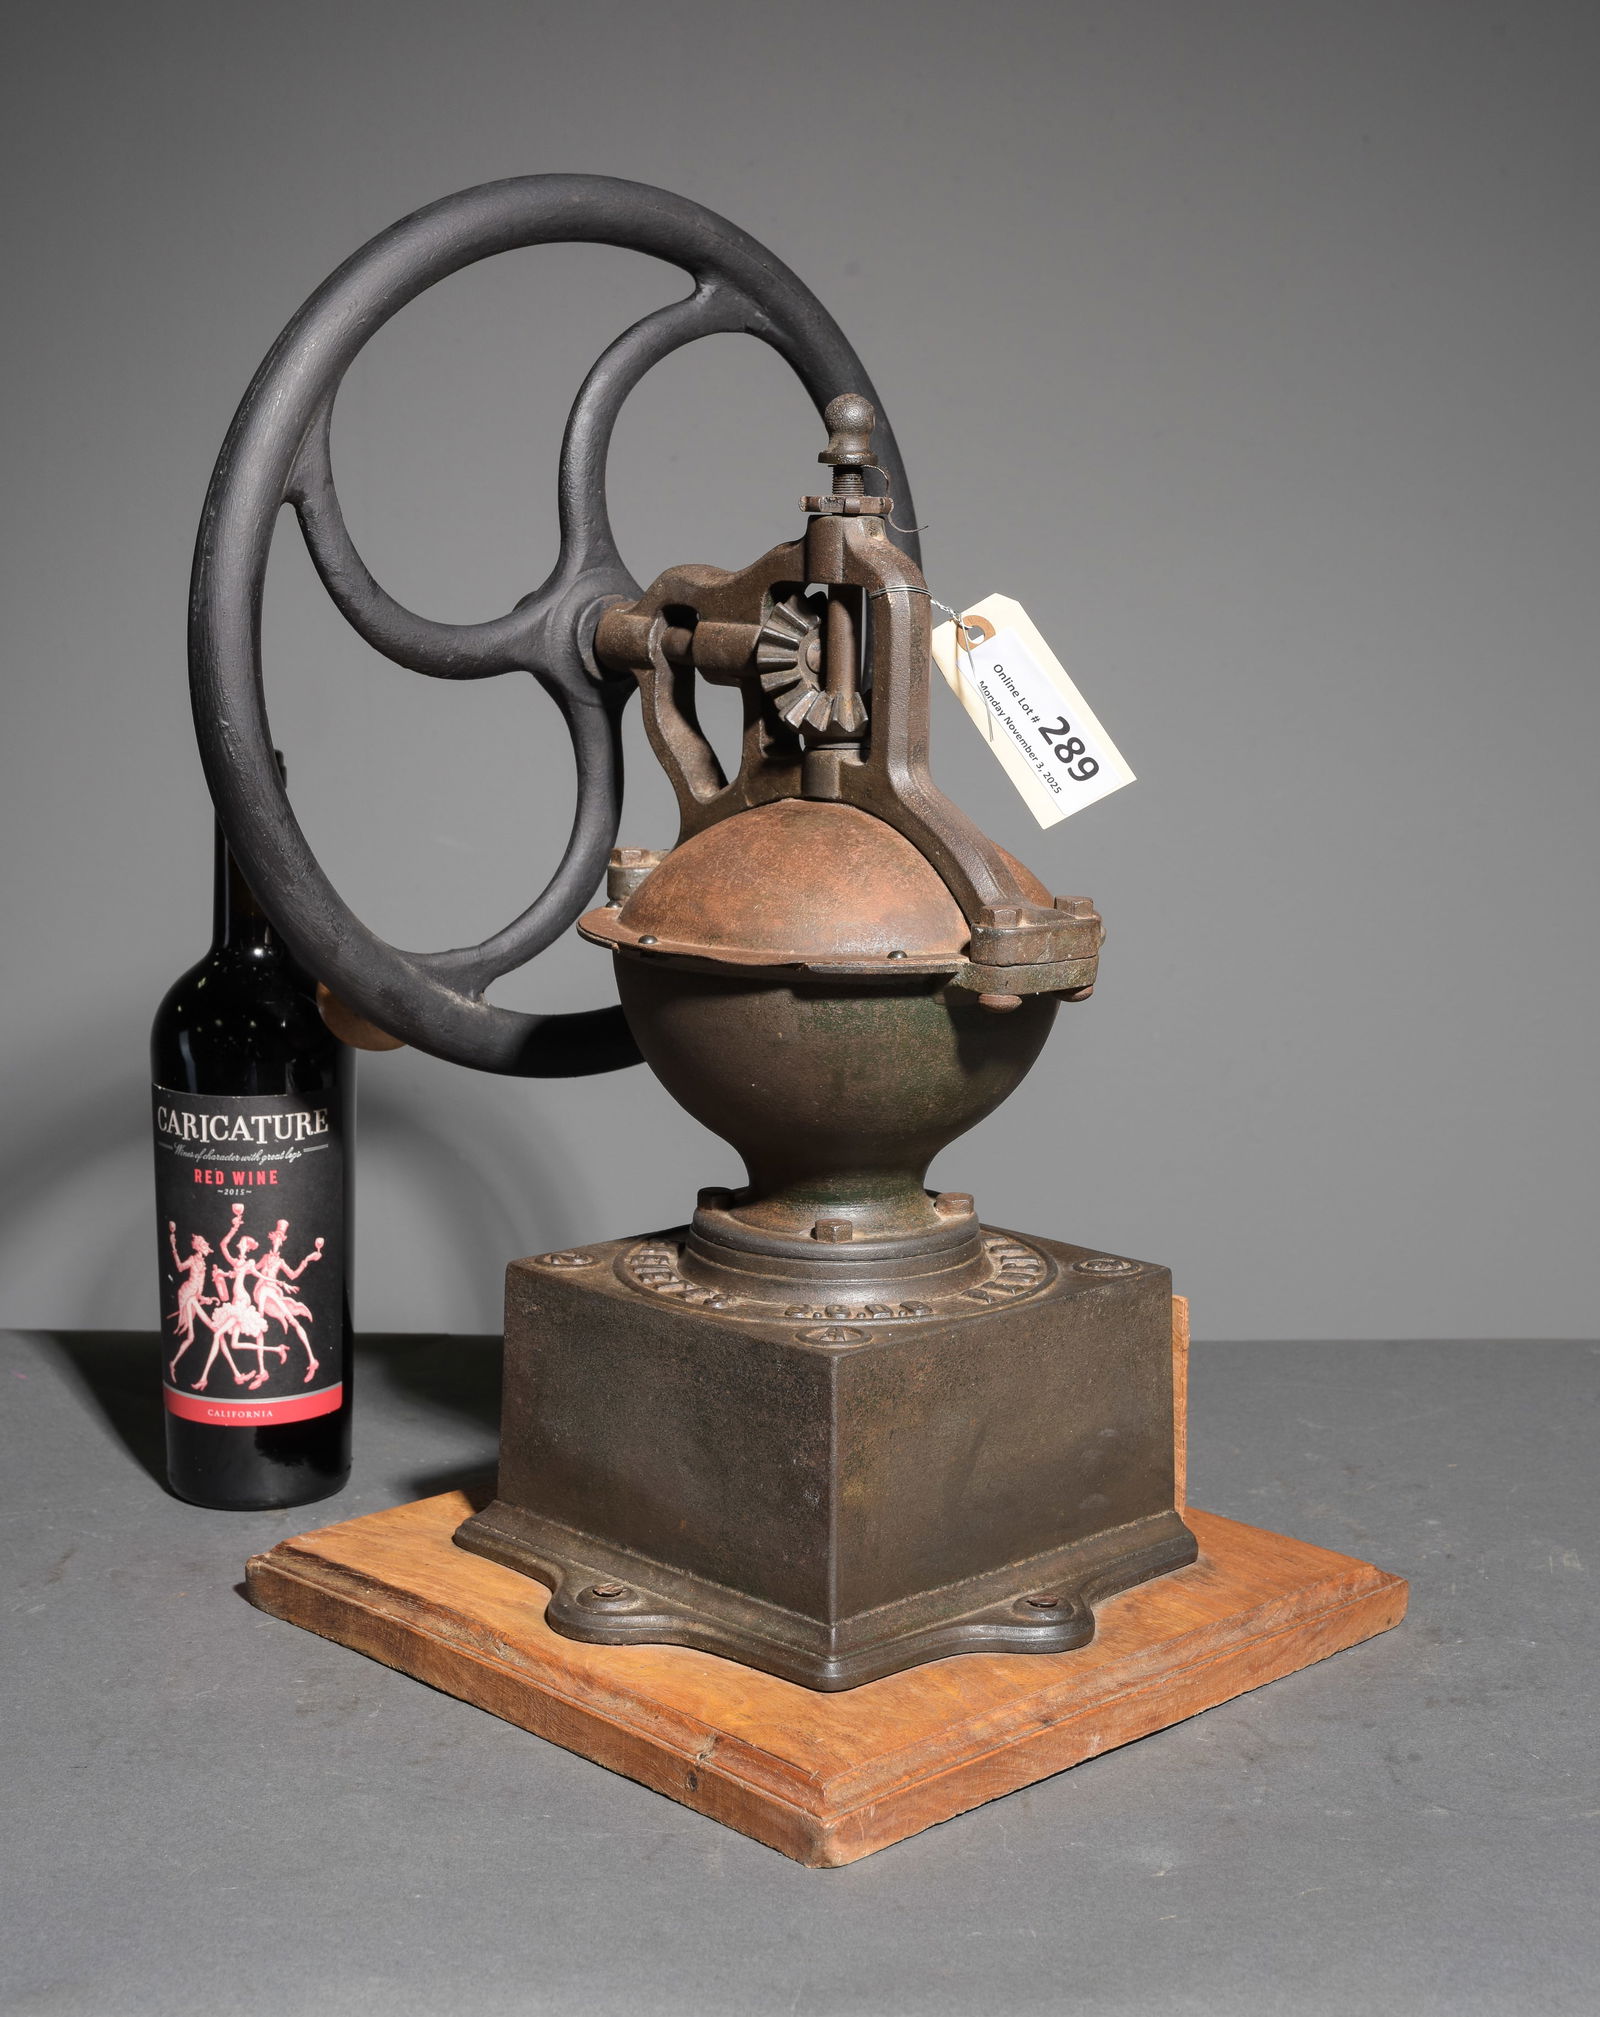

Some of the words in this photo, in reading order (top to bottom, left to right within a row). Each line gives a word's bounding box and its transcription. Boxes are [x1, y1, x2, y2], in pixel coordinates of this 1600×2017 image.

[993, 664, 1020, 698] Online
[1017, 697, 1034, 717] Lot
[1030, 715, 1041, 724] #
[979, 680, 1006, 717] Monday
[1003, 716, 1039, 762] November
[1035, 761, 1044, 773] 3,
[1043, 772, 1062, 794] 2025
[1038, 715, 1100, 782] 289
[157, 1105, 329, 1144] CARICATURE
[240, 1148, 264, 1162] with
[194, 1168, 225, 1185] RED
[232, 1169, 279, 1186] WINE
[207, 1409, 273, 1418] CALIFORNIA
